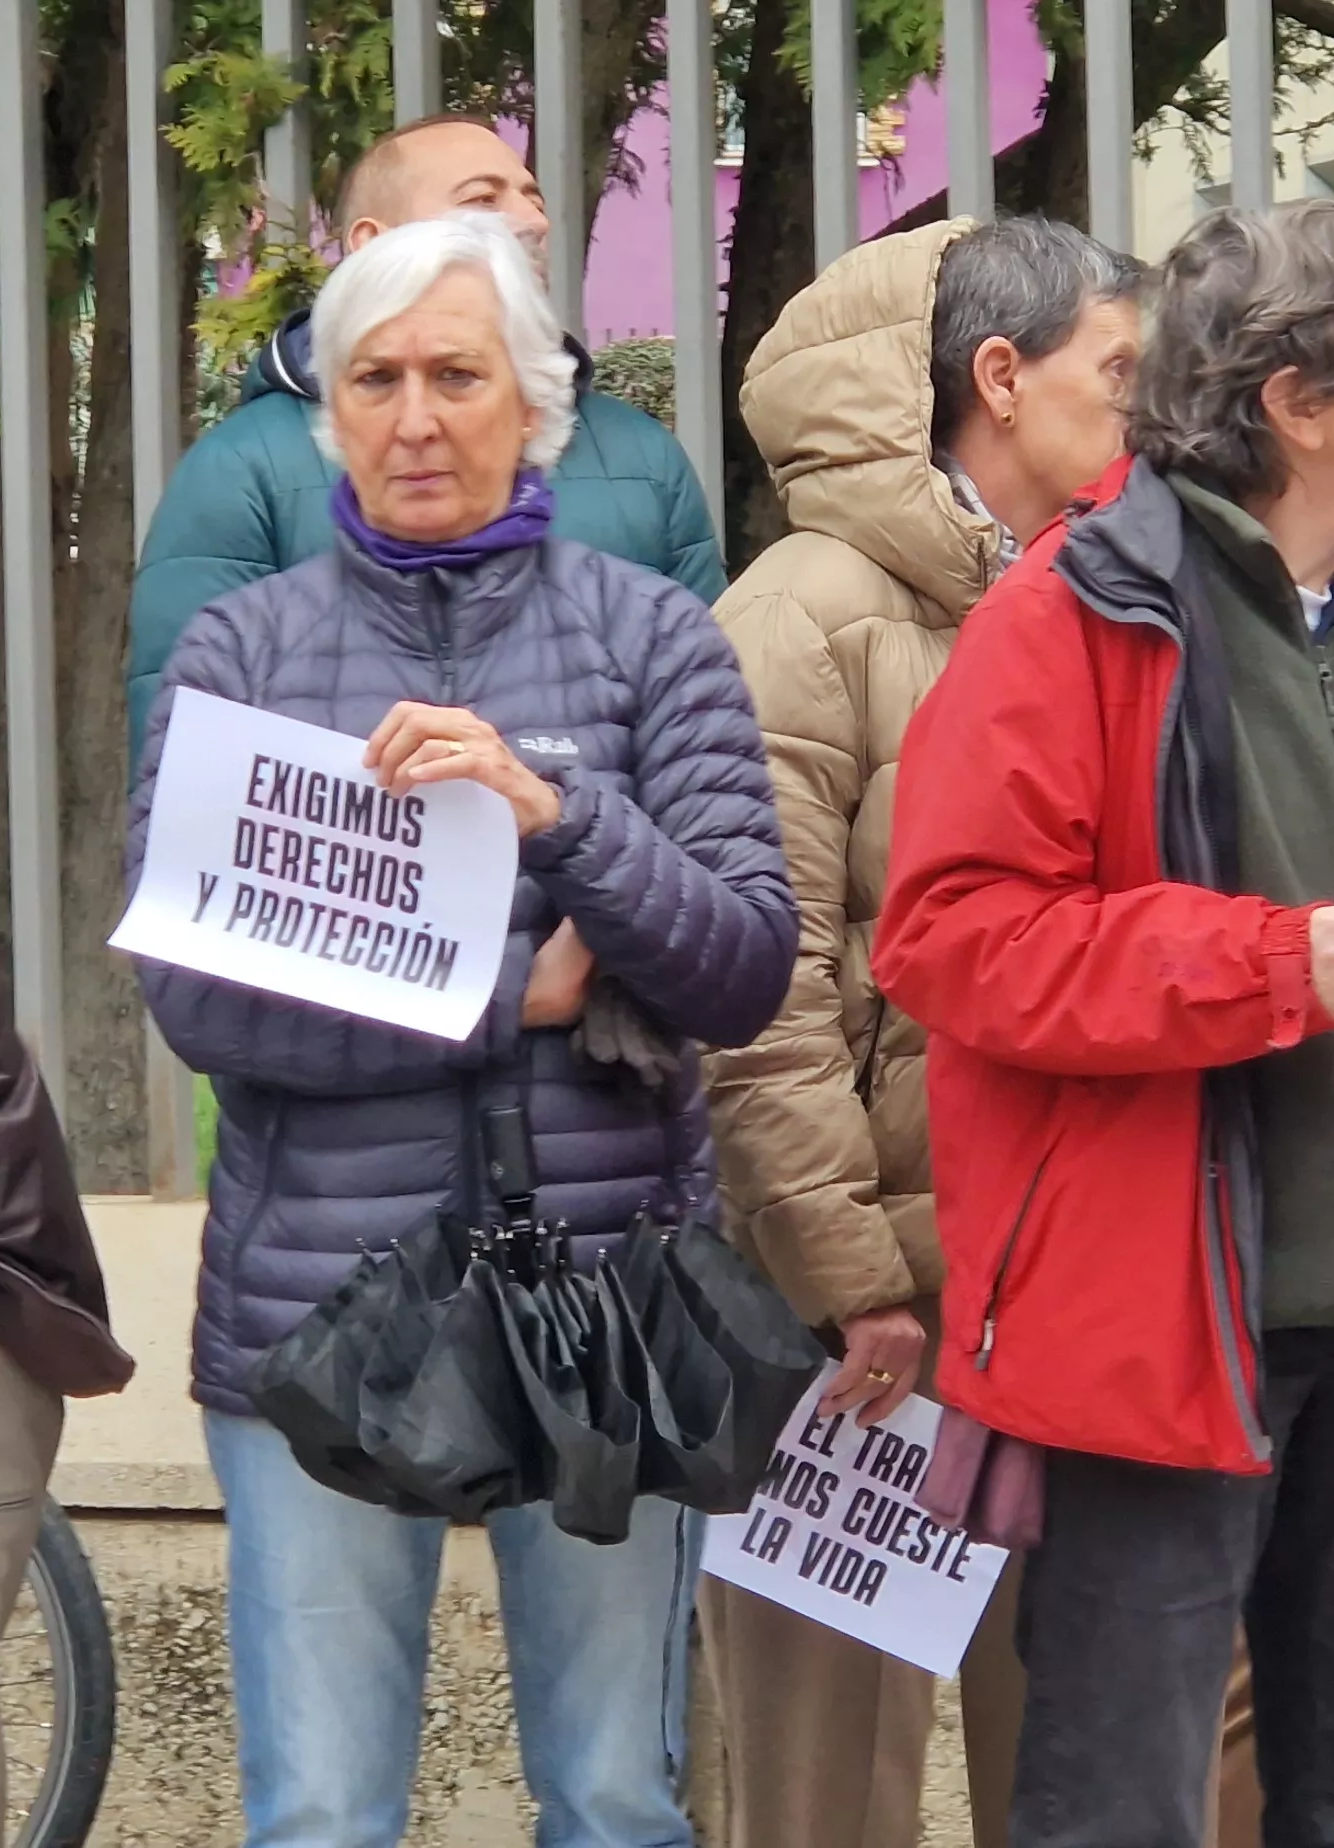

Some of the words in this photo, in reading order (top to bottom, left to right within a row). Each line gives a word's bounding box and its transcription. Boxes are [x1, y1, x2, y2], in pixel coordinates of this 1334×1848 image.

[245, 752, 425, 849] EXIGIMOS
[232, 815, 424, 915] DERECHOS
[190, 870, 220, 924] Y
[223, 880, 460, 993] PROTECCIÓN
[799, 1410, 845, 1459] EL
[852, 1424, 929, 1494] TRA
[740, 1507, 793, 1565] LA
[798, 1530, 888, 1608] VIDA
[758, 1449, 840, 1521] NOS
[840, 1486, 971, 1584] CUESTE
